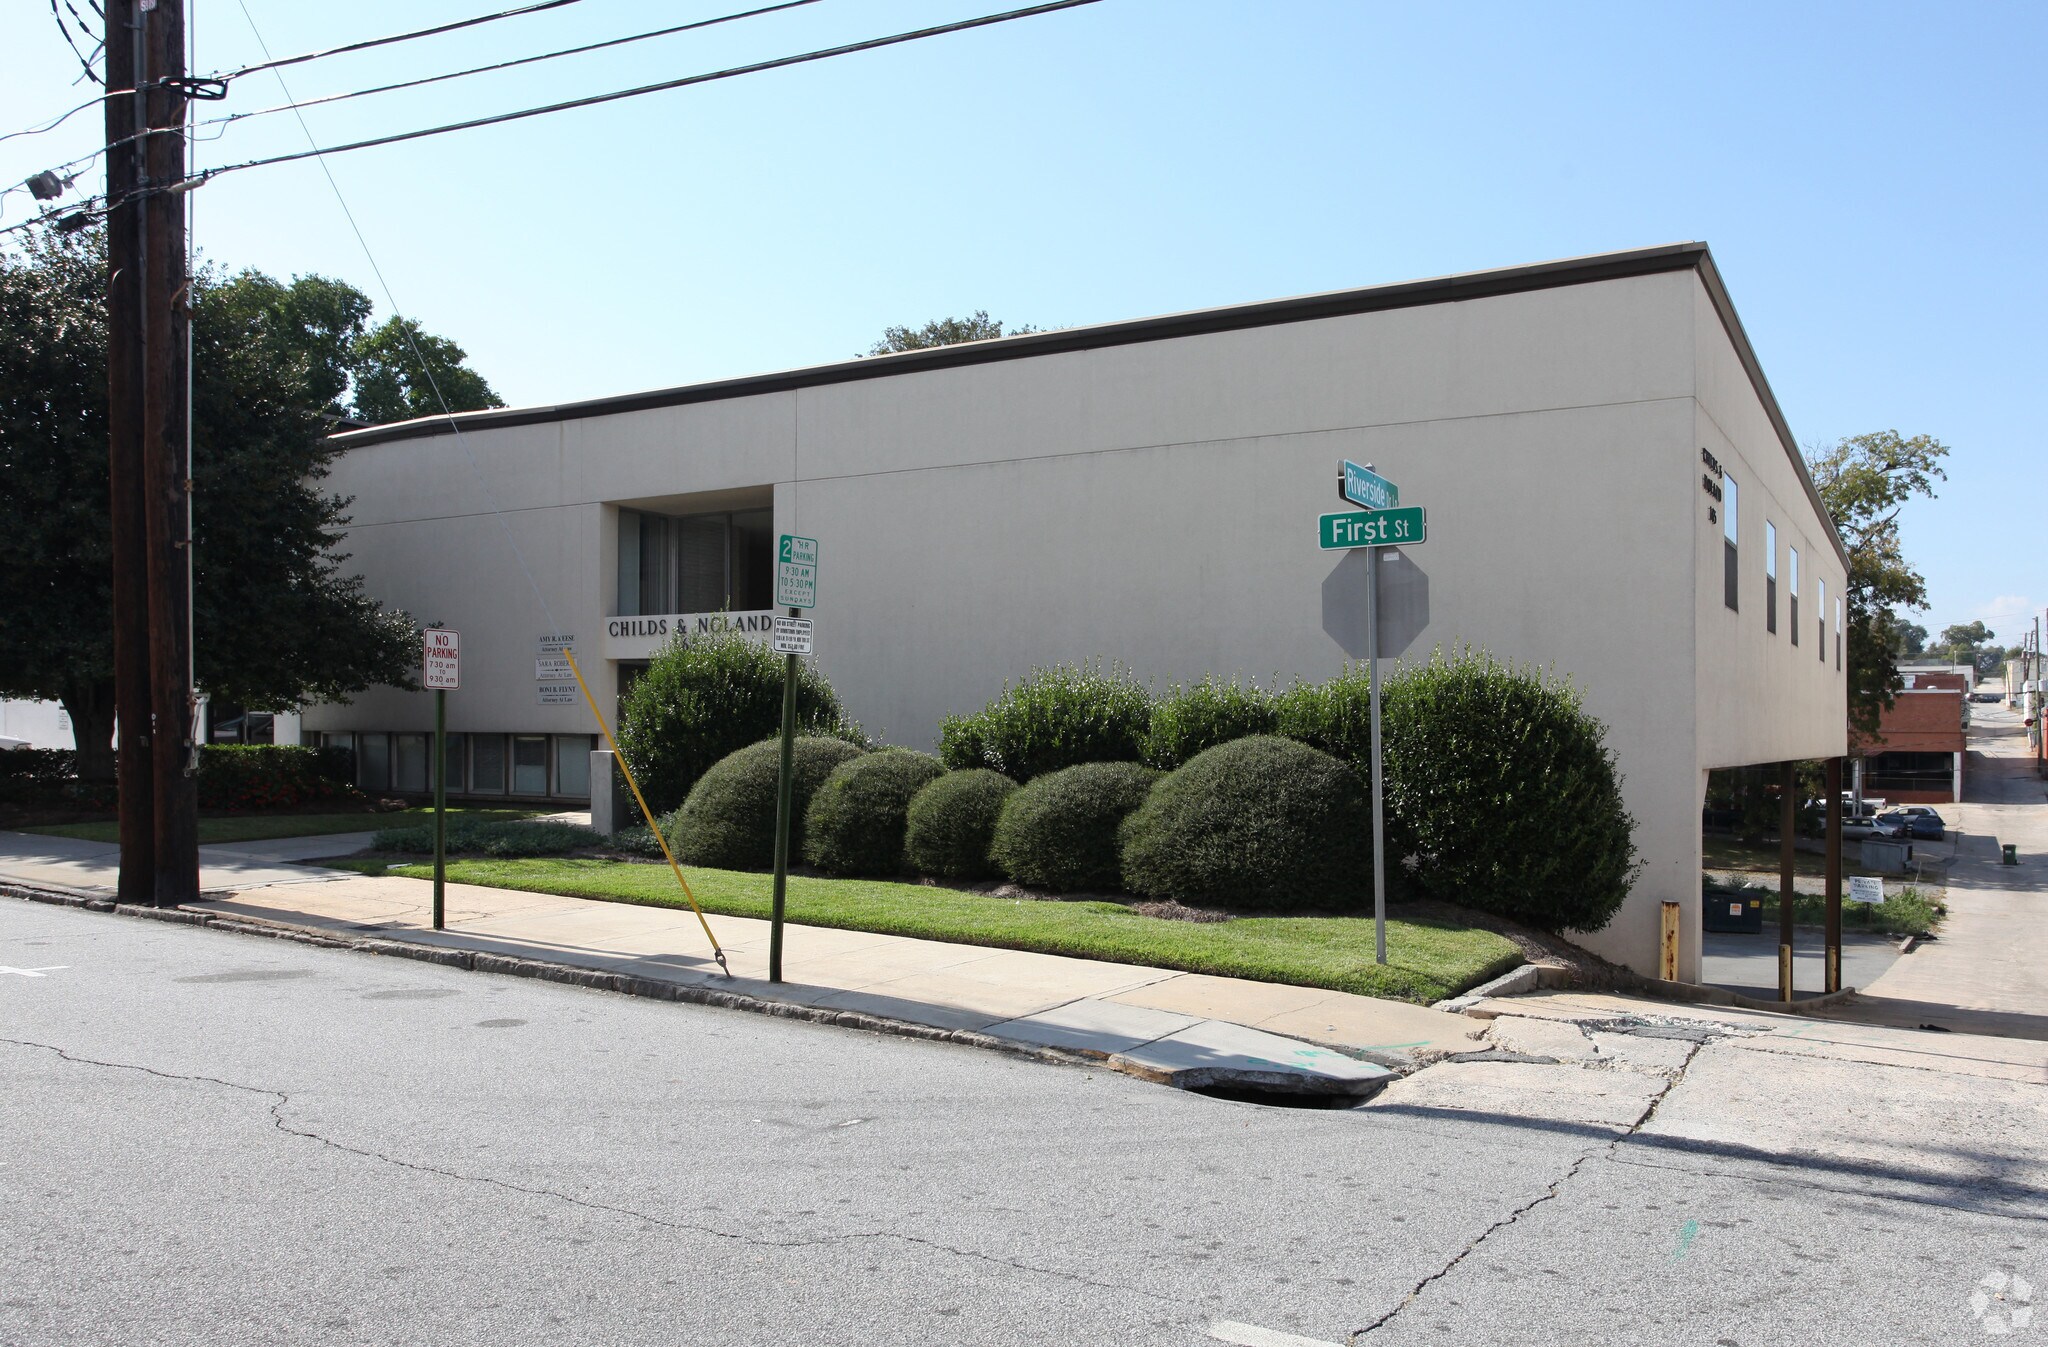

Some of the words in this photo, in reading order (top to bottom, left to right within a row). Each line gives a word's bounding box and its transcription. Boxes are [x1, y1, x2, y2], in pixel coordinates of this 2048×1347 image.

[1347, 467, 1386, 506] Riverside
[1332, 516, 1388, 543] First
[1394, 519, 1410, 538] St
[782, 540, 791, 558] 2
[798, 541, 810, 550] HR
[793, 551, 815, 562] PARKING
[801, 568, 810, 578] AM
[781, 577, 788, 587] TO
[804, 580, 813, 589] PM
[785, 589, 810, 597] EXCEPT
[780, 595, 812, 604] SUNDAYS
[608, 619, 667, 637] CHILDS
[677, 618, 687, 634] &
[698, 615, 773, 633] NOLAND
[435, 635, 449, 646] NO
[427, 646, 458, 659] PARKING
